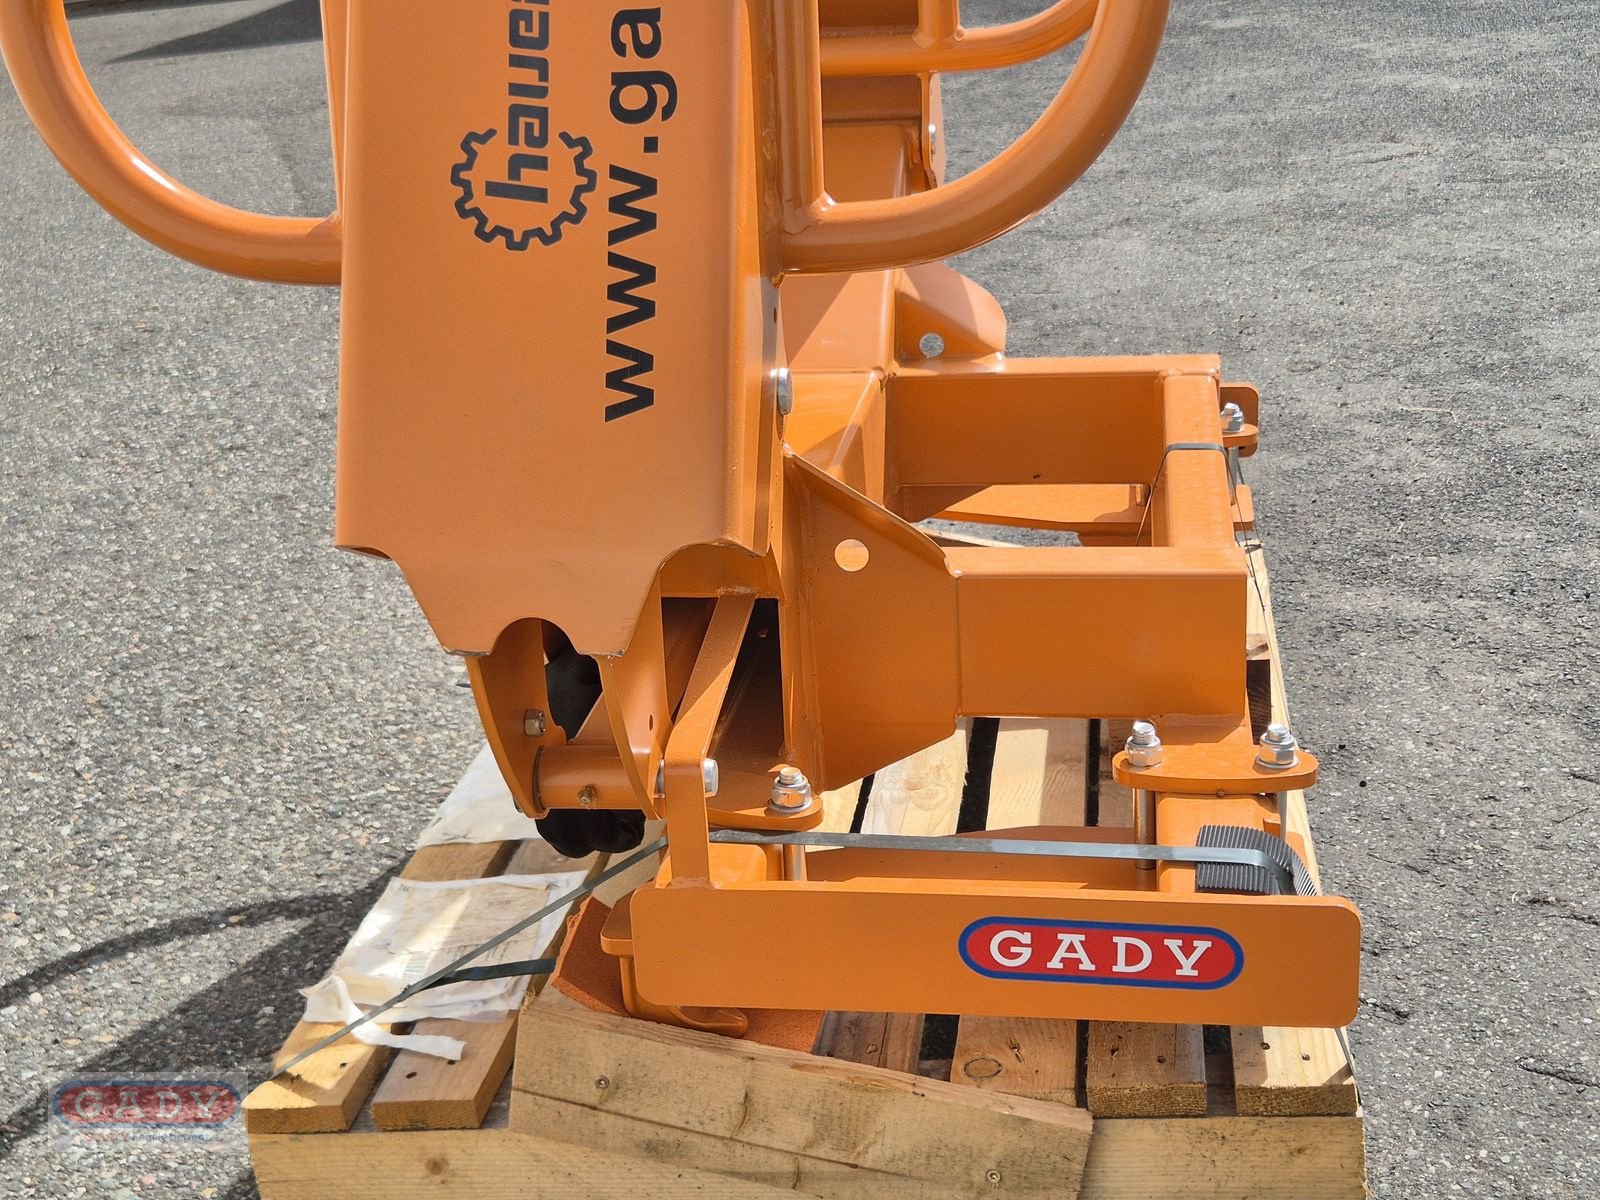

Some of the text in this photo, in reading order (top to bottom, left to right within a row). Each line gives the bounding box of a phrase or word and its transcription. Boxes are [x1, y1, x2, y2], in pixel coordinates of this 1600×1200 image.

[485, 0, 550, 204] haue
[604, 7, 678, 422] www.ga
[989, 929, 1212, 977] GADY
